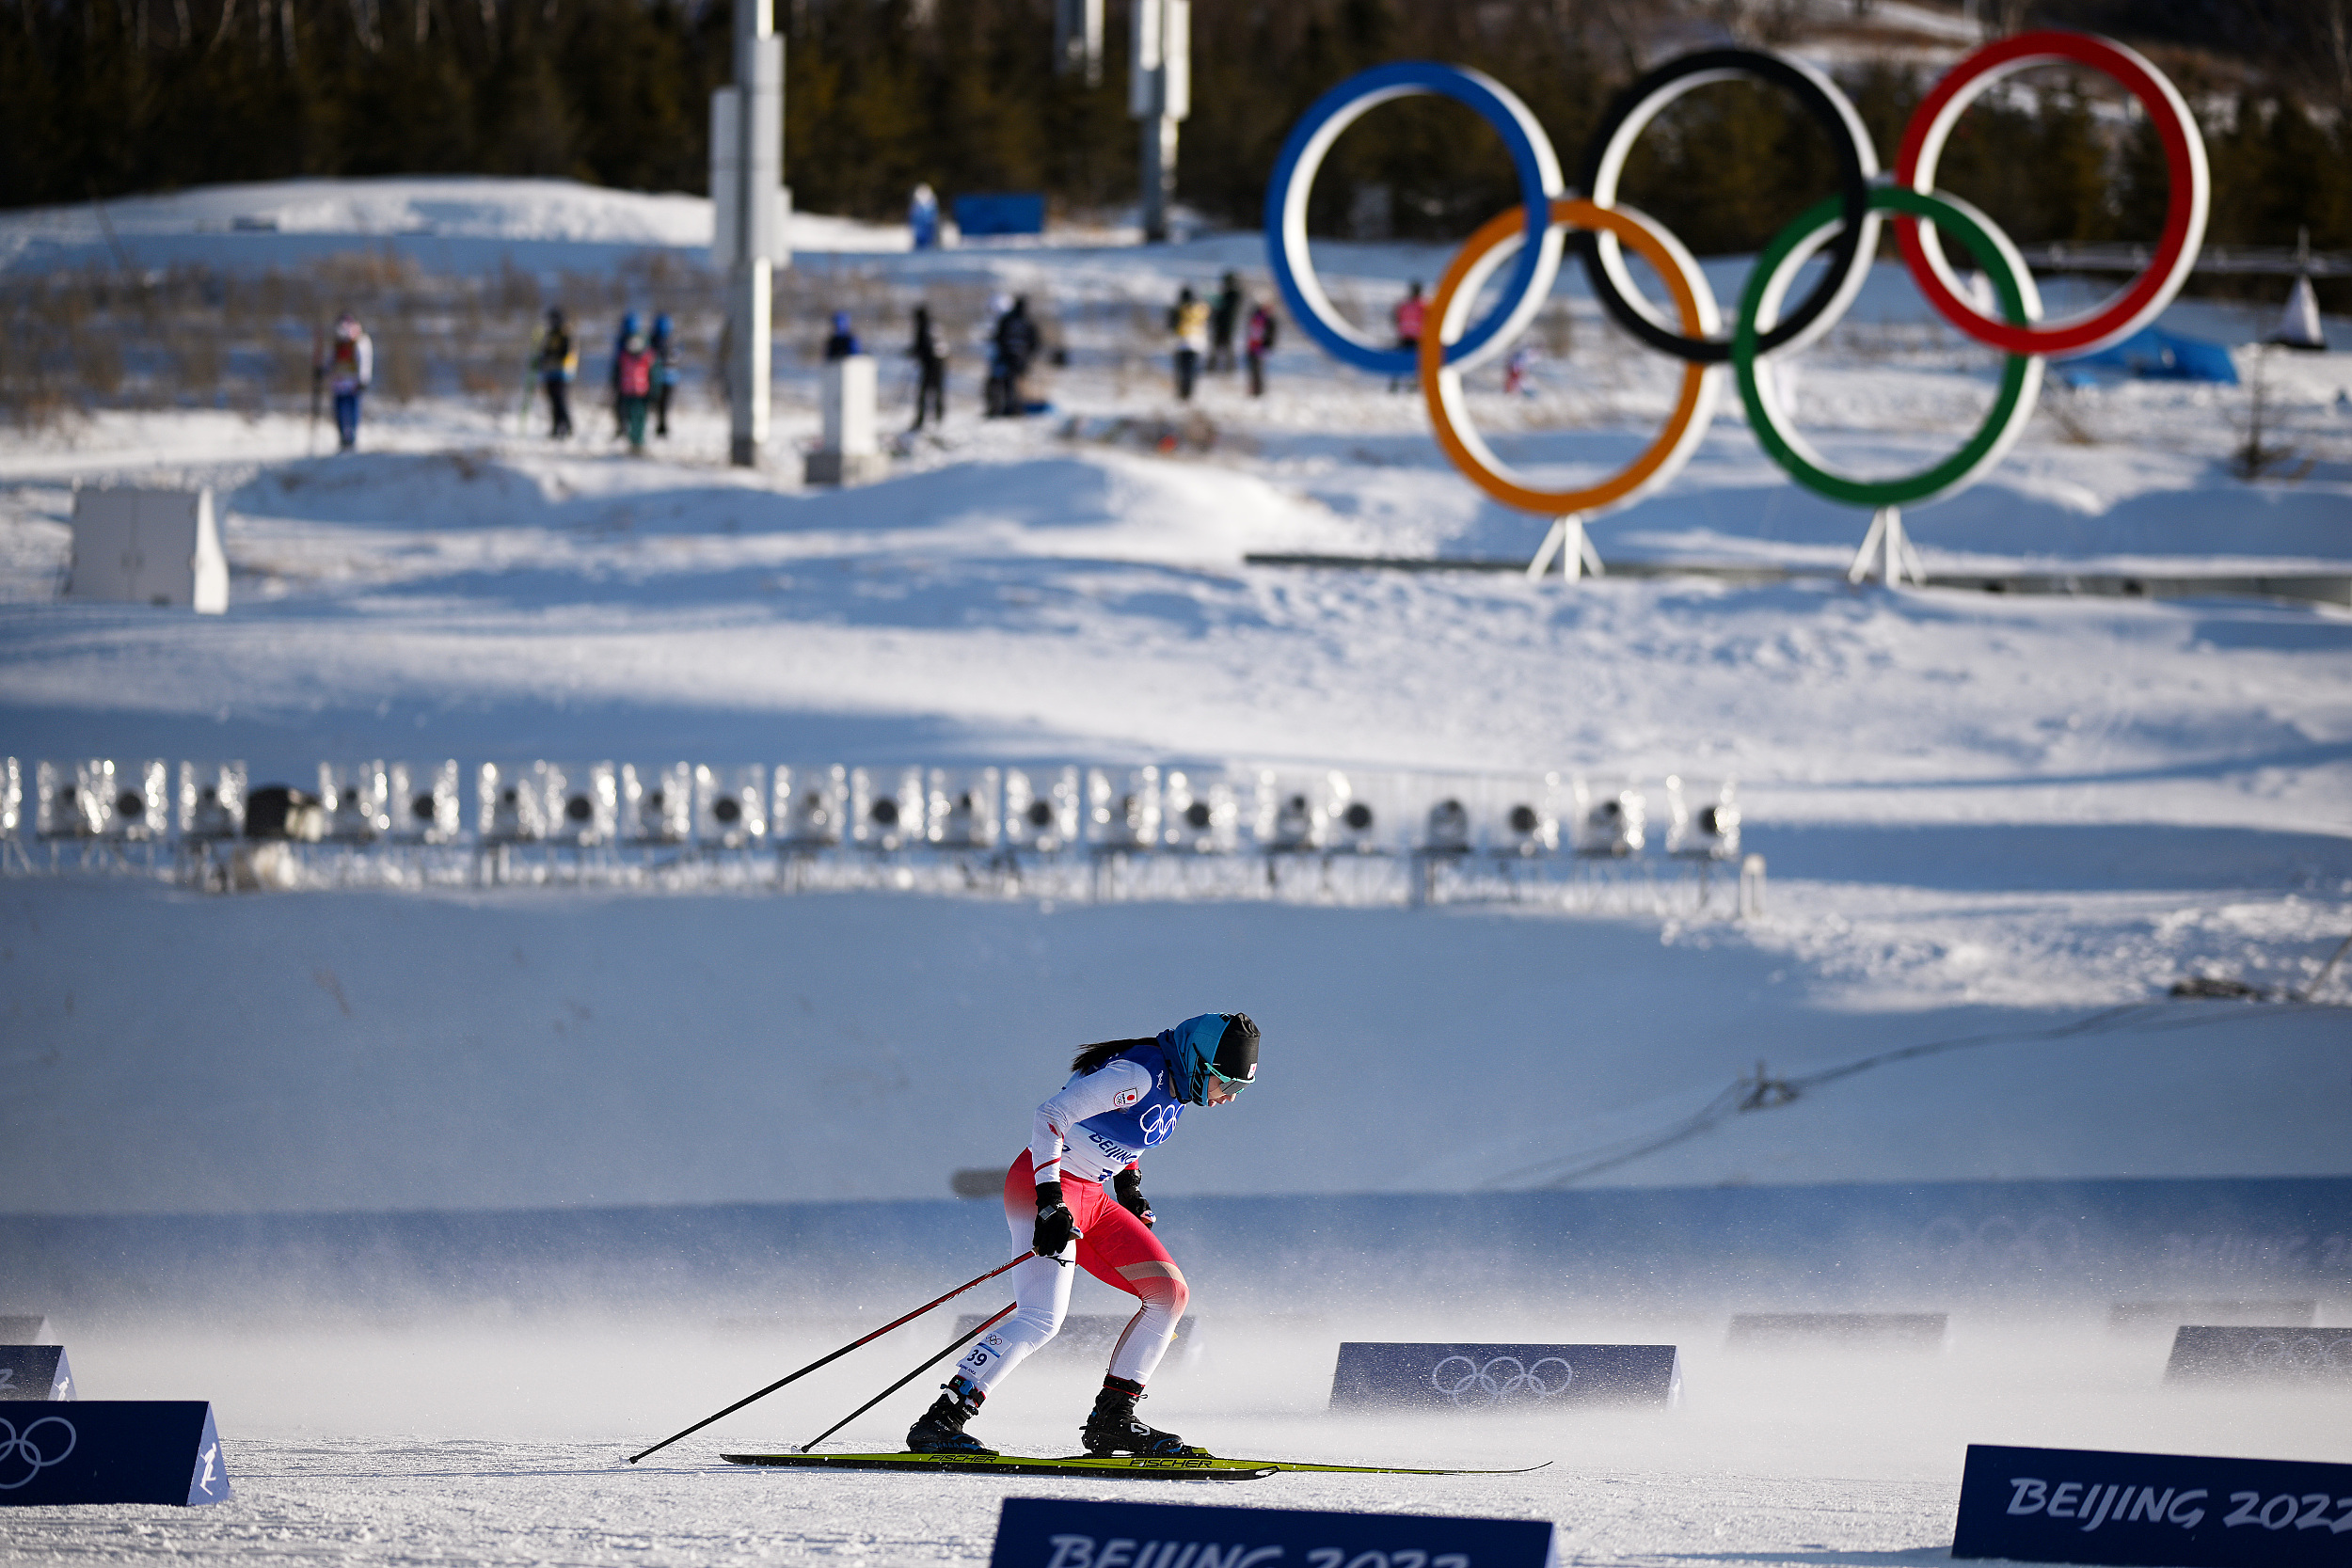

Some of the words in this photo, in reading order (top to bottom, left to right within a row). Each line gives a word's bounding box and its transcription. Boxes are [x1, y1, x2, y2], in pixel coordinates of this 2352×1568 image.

[1089, 1132, 1137, 1164] BEIJING
[967, 1349, 987, 1366] 39
[1129, 1459, 1213, 1468] FISCHER
[2006, 1478, 2208, 1532] BEIJING
[2222, 1491, 2352, 1534] 2022
